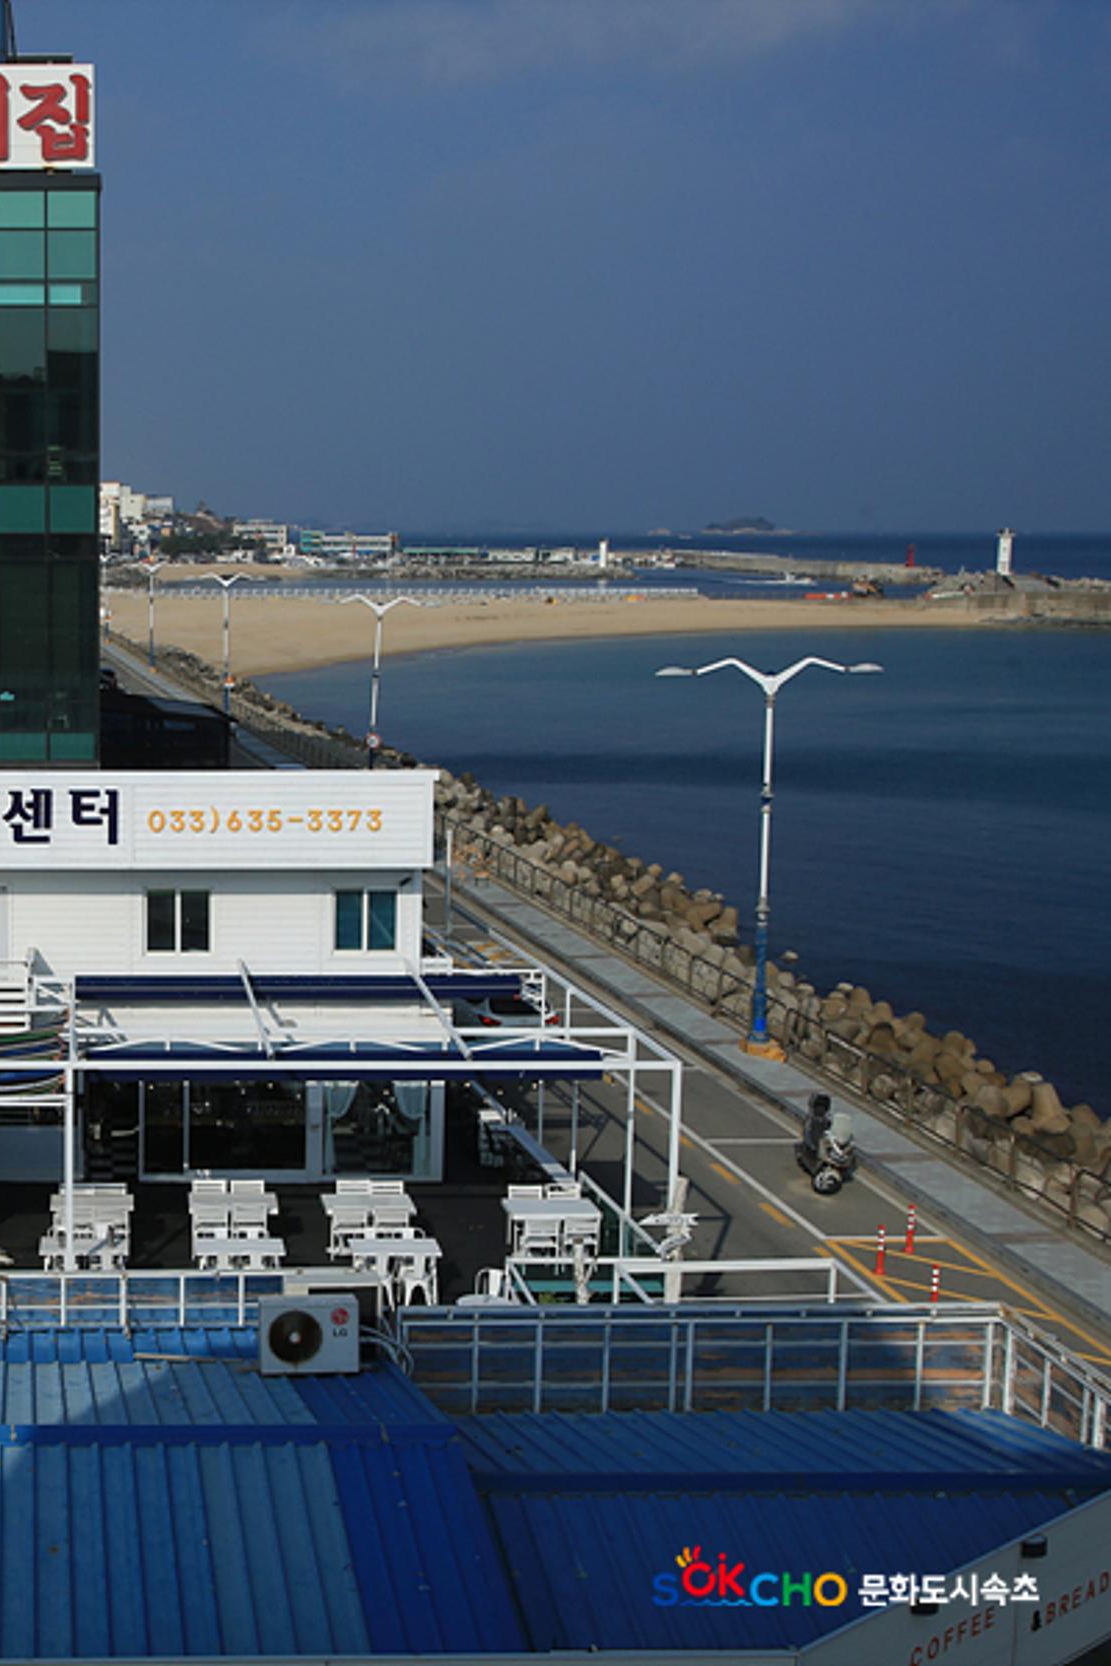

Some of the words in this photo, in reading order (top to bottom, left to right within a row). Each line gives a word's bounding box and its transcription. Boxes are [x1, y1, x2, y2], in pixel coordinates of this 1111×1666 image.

[146, 808, 383, 833] 033)635-3373
[332, 1328, 348, 1337] LG
[909, 1605, 996, 1666] COFFEE
